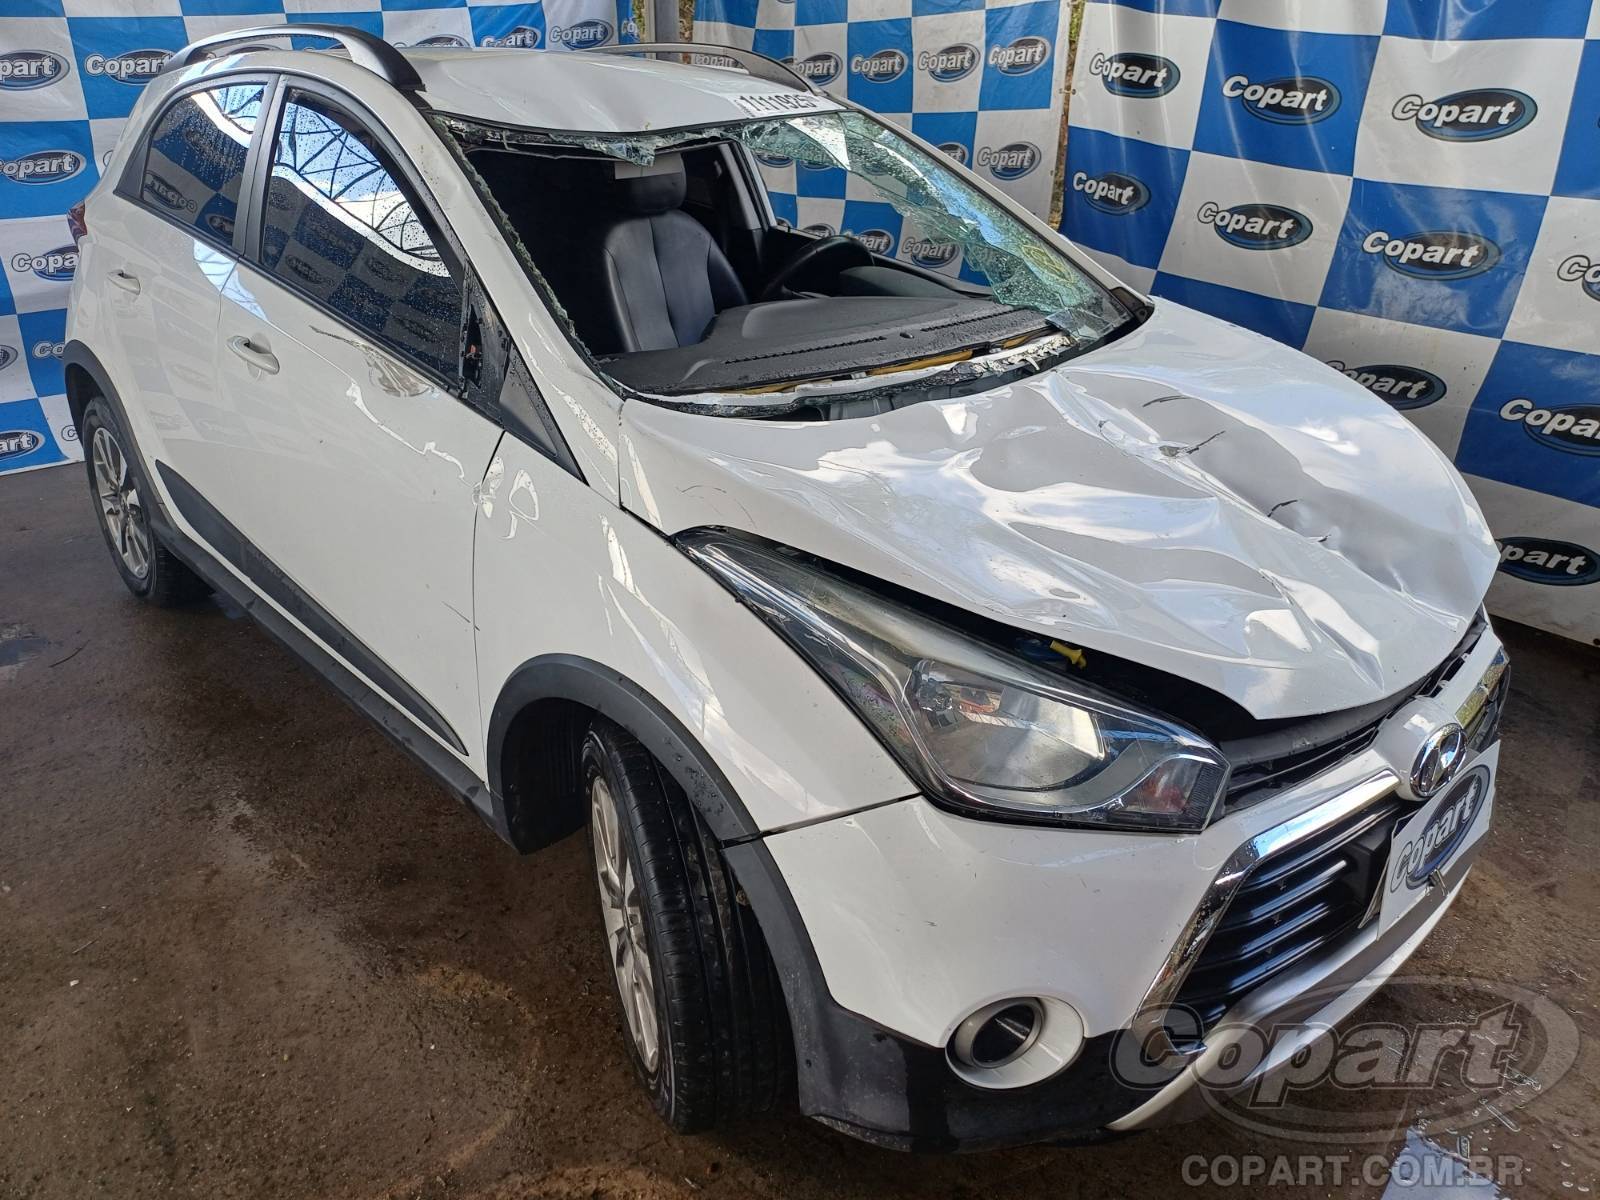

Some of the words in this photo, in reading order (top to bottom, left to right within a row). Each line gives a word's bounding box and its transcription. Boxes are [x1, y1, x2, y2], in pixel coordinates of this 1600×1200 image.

[550, 26, 605, 45] Copart
[851, 55, 902, 76] Copart
[918, 51, 971, 74] Copart
[988, 41, 1044, 69] Copart
[1089, 53, 1168, 88] Copart
[1222, 75, 1328, 112] Copart
[1392, 94, 1516, 127] Copart
[977, 146, 1032, 172] Copart
[1072, 171, 1135, 206] Copart
[1198, 201, 1296, 239] Copart
[1362, 231, 1480, 267] Copart
[1390, 777, 1479, 893] Copart
